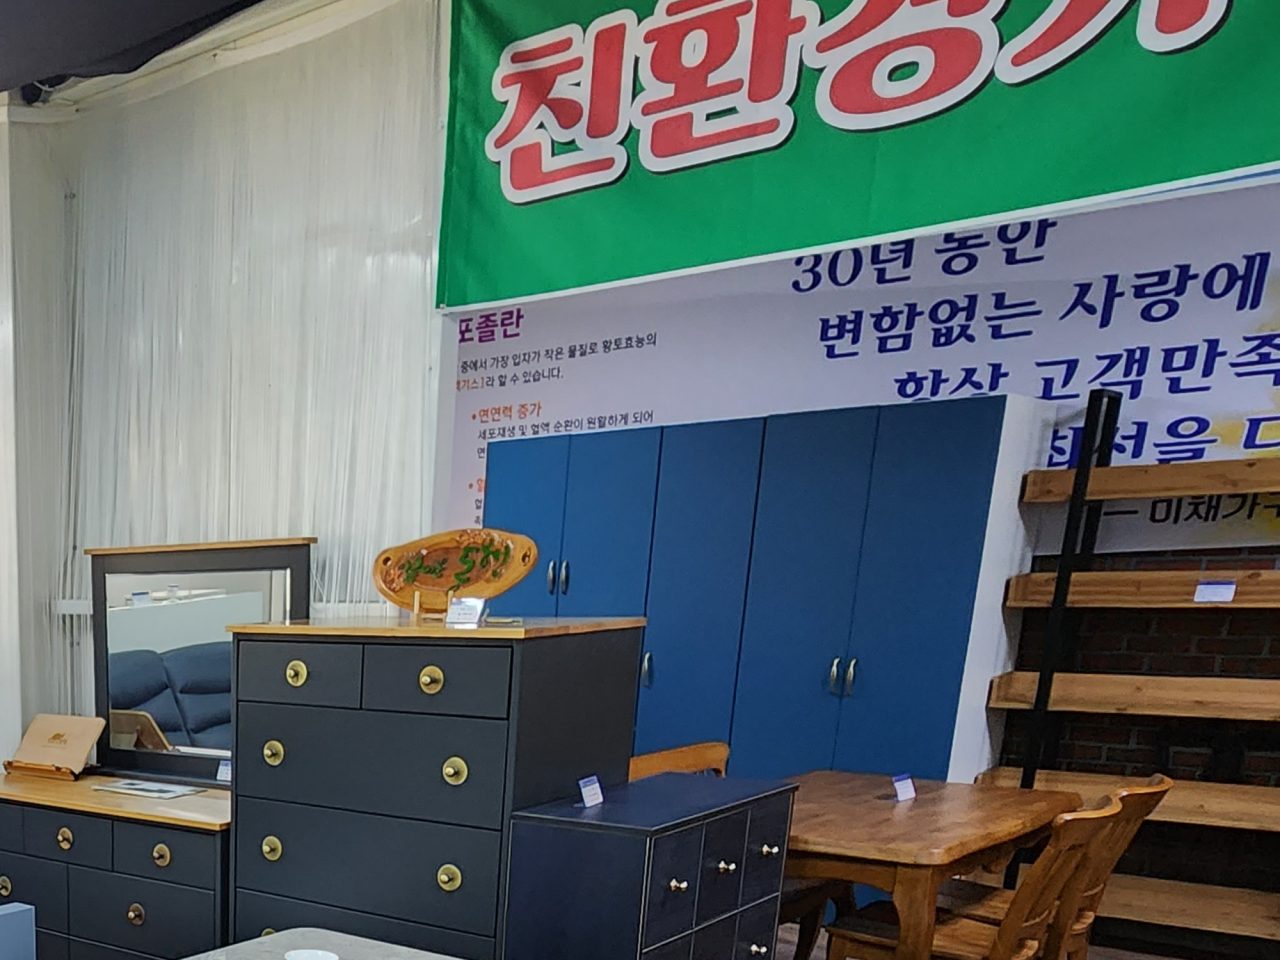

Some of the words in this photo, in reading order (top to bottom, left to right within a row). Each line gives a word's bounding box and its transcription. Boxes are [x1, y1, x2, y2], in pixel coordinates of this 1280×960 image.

[791, 238, 916, 294] 30년
[934, 218, 1059, 277] 동안
[818, 291, 1043, 360] 변함없는
[1058, 250, 1272, 330] 사랑에
[1033, 331, 1280, 401] 고객만족
